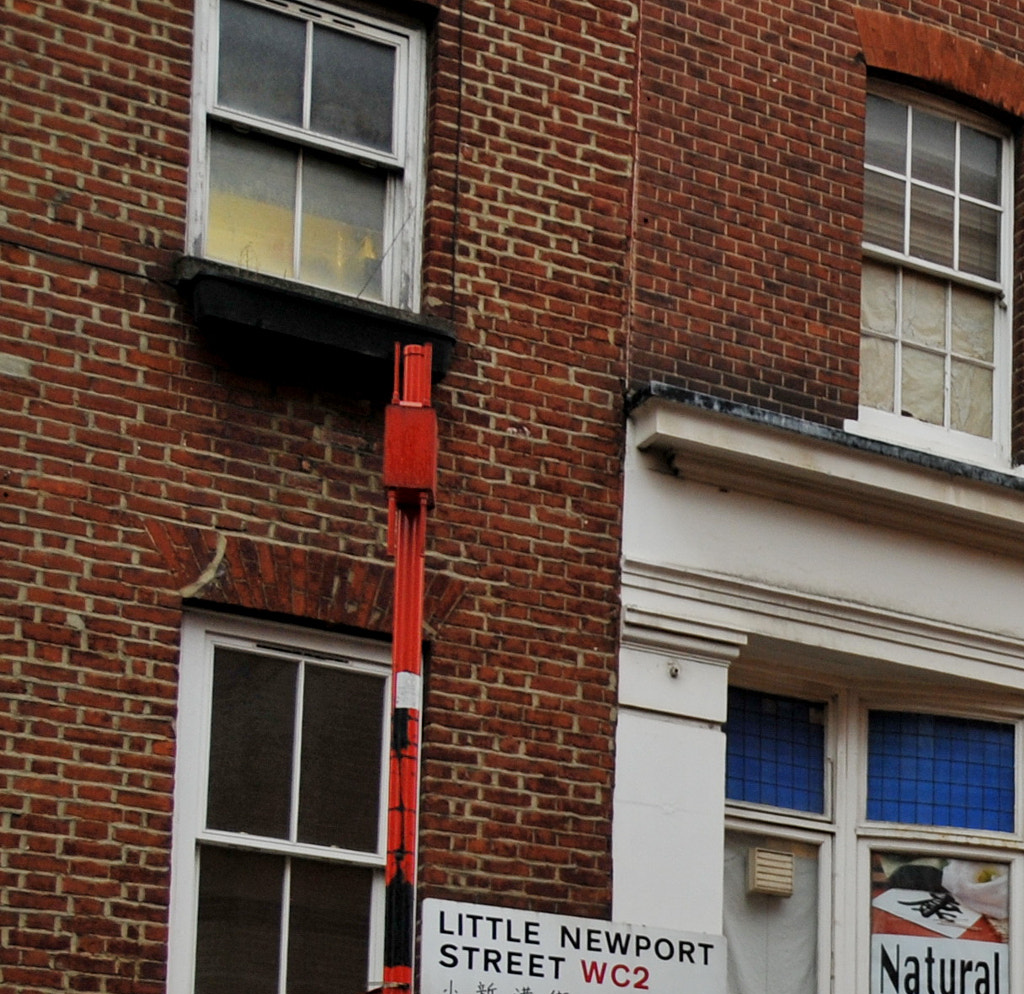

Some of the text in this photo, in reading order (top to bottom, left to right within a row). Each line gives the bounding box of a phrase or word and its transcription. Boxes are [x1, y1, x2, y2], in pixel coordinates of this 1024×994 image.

[438, 910, 714, 966] LITTLE NEWPORT
[438, 944, 650, 990] STREET WC2
